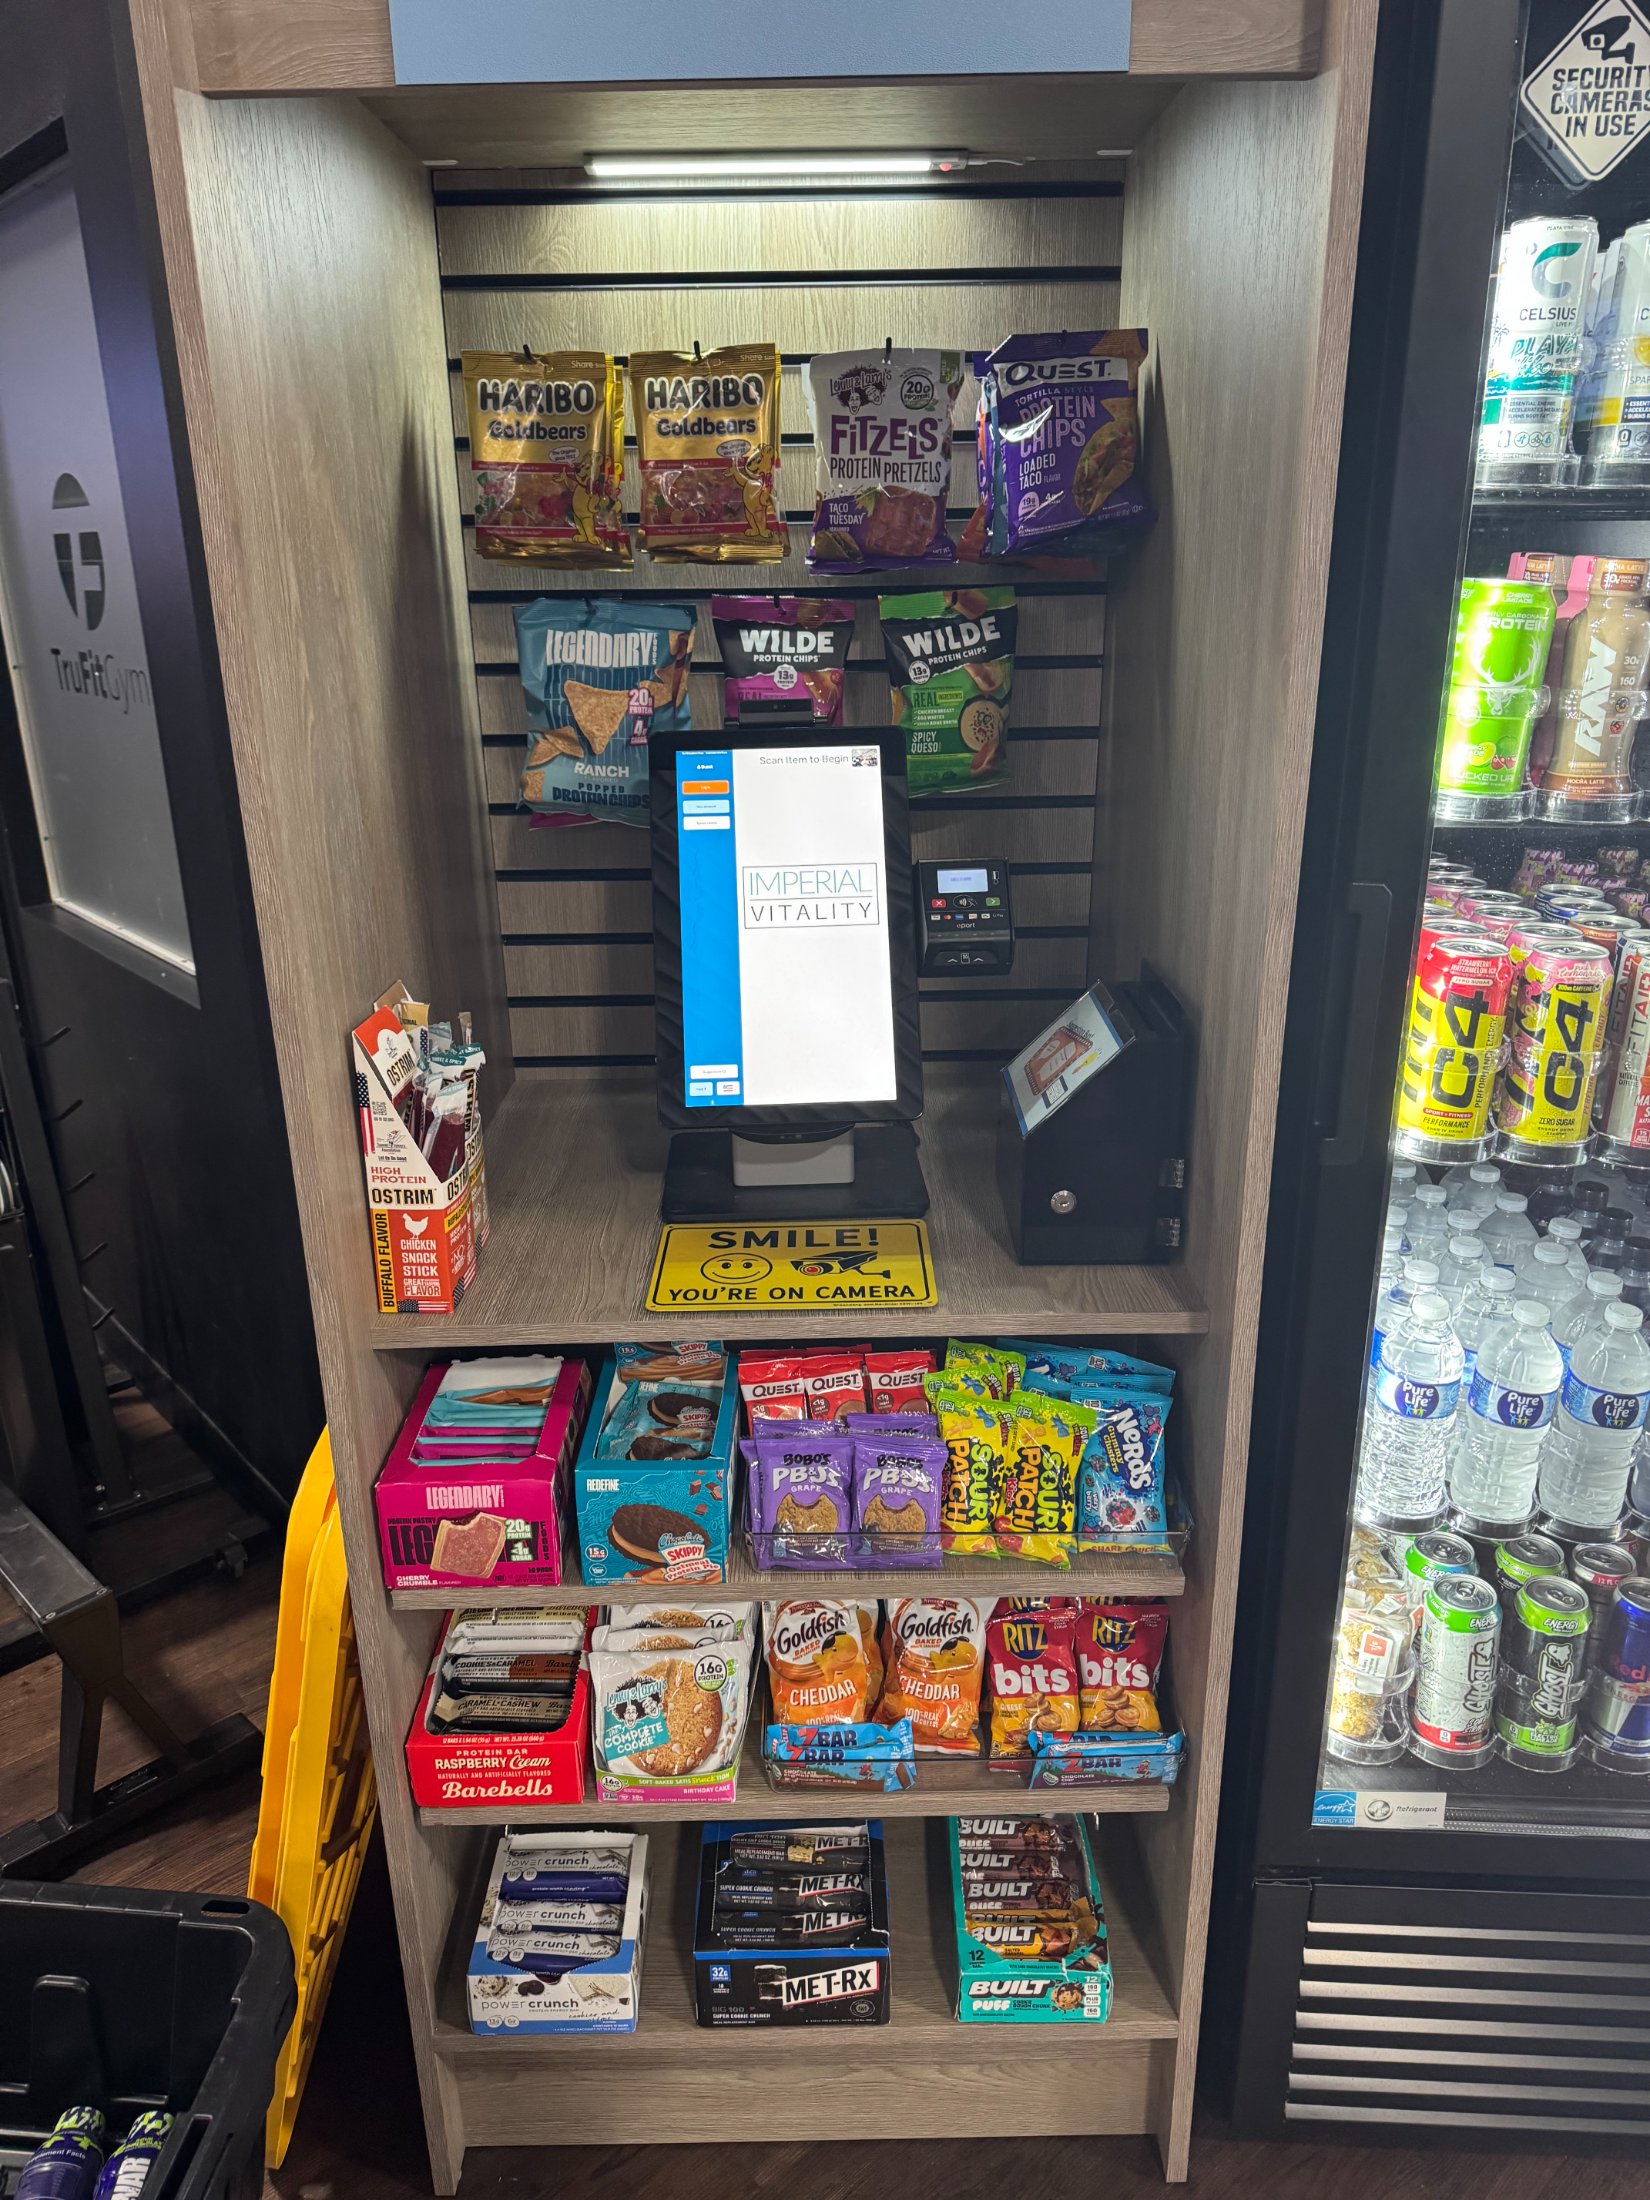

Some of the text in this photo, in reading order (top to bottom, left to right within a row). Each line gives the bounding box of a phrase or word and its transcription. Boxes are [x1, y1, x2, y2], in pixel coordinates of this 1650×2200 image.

[1552, 66, 1650, 91] SECURIT
[1565, 114, 1637, 138] IN USE
[1519, 307, 1577, 321] CELSIUS
[477, 378, 596, 414] HARIBO
[645, 373, 764, 411] HARIBO
[1015, 388, 1060, 407] TORTILLA
[1019, 395, 1096, 424] PROTEIN
[488, 420, 586, 442] Goldbears
[656, 417, 757, 437] Goldbears
[1019, 419, 1086, 458] CHIPS
[830, 457, 942, 484] PROTEIN PRETZELS
[1019, 453, 1056, 477] LOADED
[1019, 472, 1042, 490] TACO
[829, 503, 849, 514] TACO
[829, 512, 866, 525] TUESDAY
[739, 629, 834, 653] WILDE
[902, 616, 1001, 658] WILDE
[546, 629, 653, 668] LEGENDARY
[928, 646, 988, 666] PROTEIN CHIPS
[753, 654, 819, 663] PROTEIN CHIPS
[1620, 677, 1635, 686] 160
[913, 690, 940, 708] REAL
[629, 706, 653, 715] PROTEIN
[912, 731, 937, 743] SPICY
[911, 742, 939, 753] QUESO
[760, 755, 849, 765] Scan Item to Begin
[574, 762, 630, 777] RANCH
[578, 782, 625, 793] POPPED
[749, 869, 873, 896] IMPERIAL
[750, 902, 872, 922] VITALITY
[1450, 964, 1486, 973] WATERMELON
[1457, 958, 1492, 967] STRAWBERRY
[1431, 990, 1490, 1109] C4
[1545, 998, 1595, 1112] C4
[386, 1052, 417, 1087] OSTRIM
[1424, 1109, 1473, 1119] SPORT FITNESS
[1539, 1117, 1575, 1126] ZERO SUGAR
[1422, 1117, 1470, 1129] PERFORMANCE
[370, 1166, 401, 1175] HIGH
[371, 1175, 427, 1184] PROTEIN
[371, 1188, 434, 1205] OSTRIM
[400, 1239, 437, 1251] CHICKEN
[707, 1227, 880, 1249] SMILE!
[374, 1213, 395, 1307] BUFFALO FLAVOR
[401, 1252, 438, 1264] SNACK
[403, 1265, 439, 1277] STICK
[403, 1278, 425, 1286] GREAT
[405, 1286, 441, 1296] FLAVOR
[669, 1285, 916, 1302] YOU'RE ON CAMERA
[678, 1343, 707, 1353] SKIPPY
[812, 1373, 859, 1392] QUEST
[878, 1372, 926, 1388] QUEST
[752, 1382, 799, 1397] QUEST
[1402, 1382, 1434, 1397] Pure
[1404, 1393, 1430, 1407] Life
[1507, 1392, 1540, 1407] Pure
[1603, 1394, 1636, 1408] Pure
[683, 1413, 710, 1422] SKIPPY
[1510, 1403, 1533, 1418] Life
[1605, 1405, 1629, 1418] Life
[783, 1453, 832, 1467] BOBO'S
[586, 1479, 619, 1493] REDEFINE
[947, 1438, 971, 1523] PATCH
[970, 1443, 994, 1521] SOUR
[791, 1484, 822, 1493] GRAPE
[881, 1487, 913, 1496] GRAPE
[1012, 1446, 1042, 1532] PATCH
[1036, 1447, 1061, 1532] SOUR
[426, 1485, 500, 1510] LEGENDARY
[667, 1546, 703, 1562] SKIPPY
[668, 1558, 711, 1573] Oatmeal
[666, 1567, 702, 1580] Protein
[901, 1612, 971, 1640] Goldfish
[1092, 1615, 1137, 1645] RITZ
[1543, 1618, 1579, 1630] ENERGY
[776, 1610, 847, 1655] Goldfish
[1002, 1622, 1049, 1653] RITZ
[794, 1639, 821, 1657] BAKED
[1079, 1654, 1150, 1687] bits
[993, 1663, 1070, 1695] bits
[790, 1679, 857, 1706] CHEDDAR
[900, 1676, 960, 1701] CHEDDAR
[605, 1722, 663, 1748] COMPLETE
[617, 1737, 654, 1754] COOKIE
[435, 1755, 551, 1770] RASPBERRY Cream
[442, 1779, 553, 1799] Barebells
[683, 1786, 714, 1794] BIRTHDAY
[959, 1820, 1020, 1835] BUILT
[544, 1856, 589, 1867] crunch
[968, 1882, 1032, 1897] BUILT
[540, 1910, 586, 1921] crunch
[971, 1926, 1035, 1942] BUILT
[534, 1939, 580, 1950] crunch
[968, 1950, 985, 1960] 12
[969, 1980, 1050, 1996] BUILT
[528, 1999, 579, 2008] crunch
[972, 2000, 1011, 2011] PUFF
[65, 2149, 86, 2160] Facts
